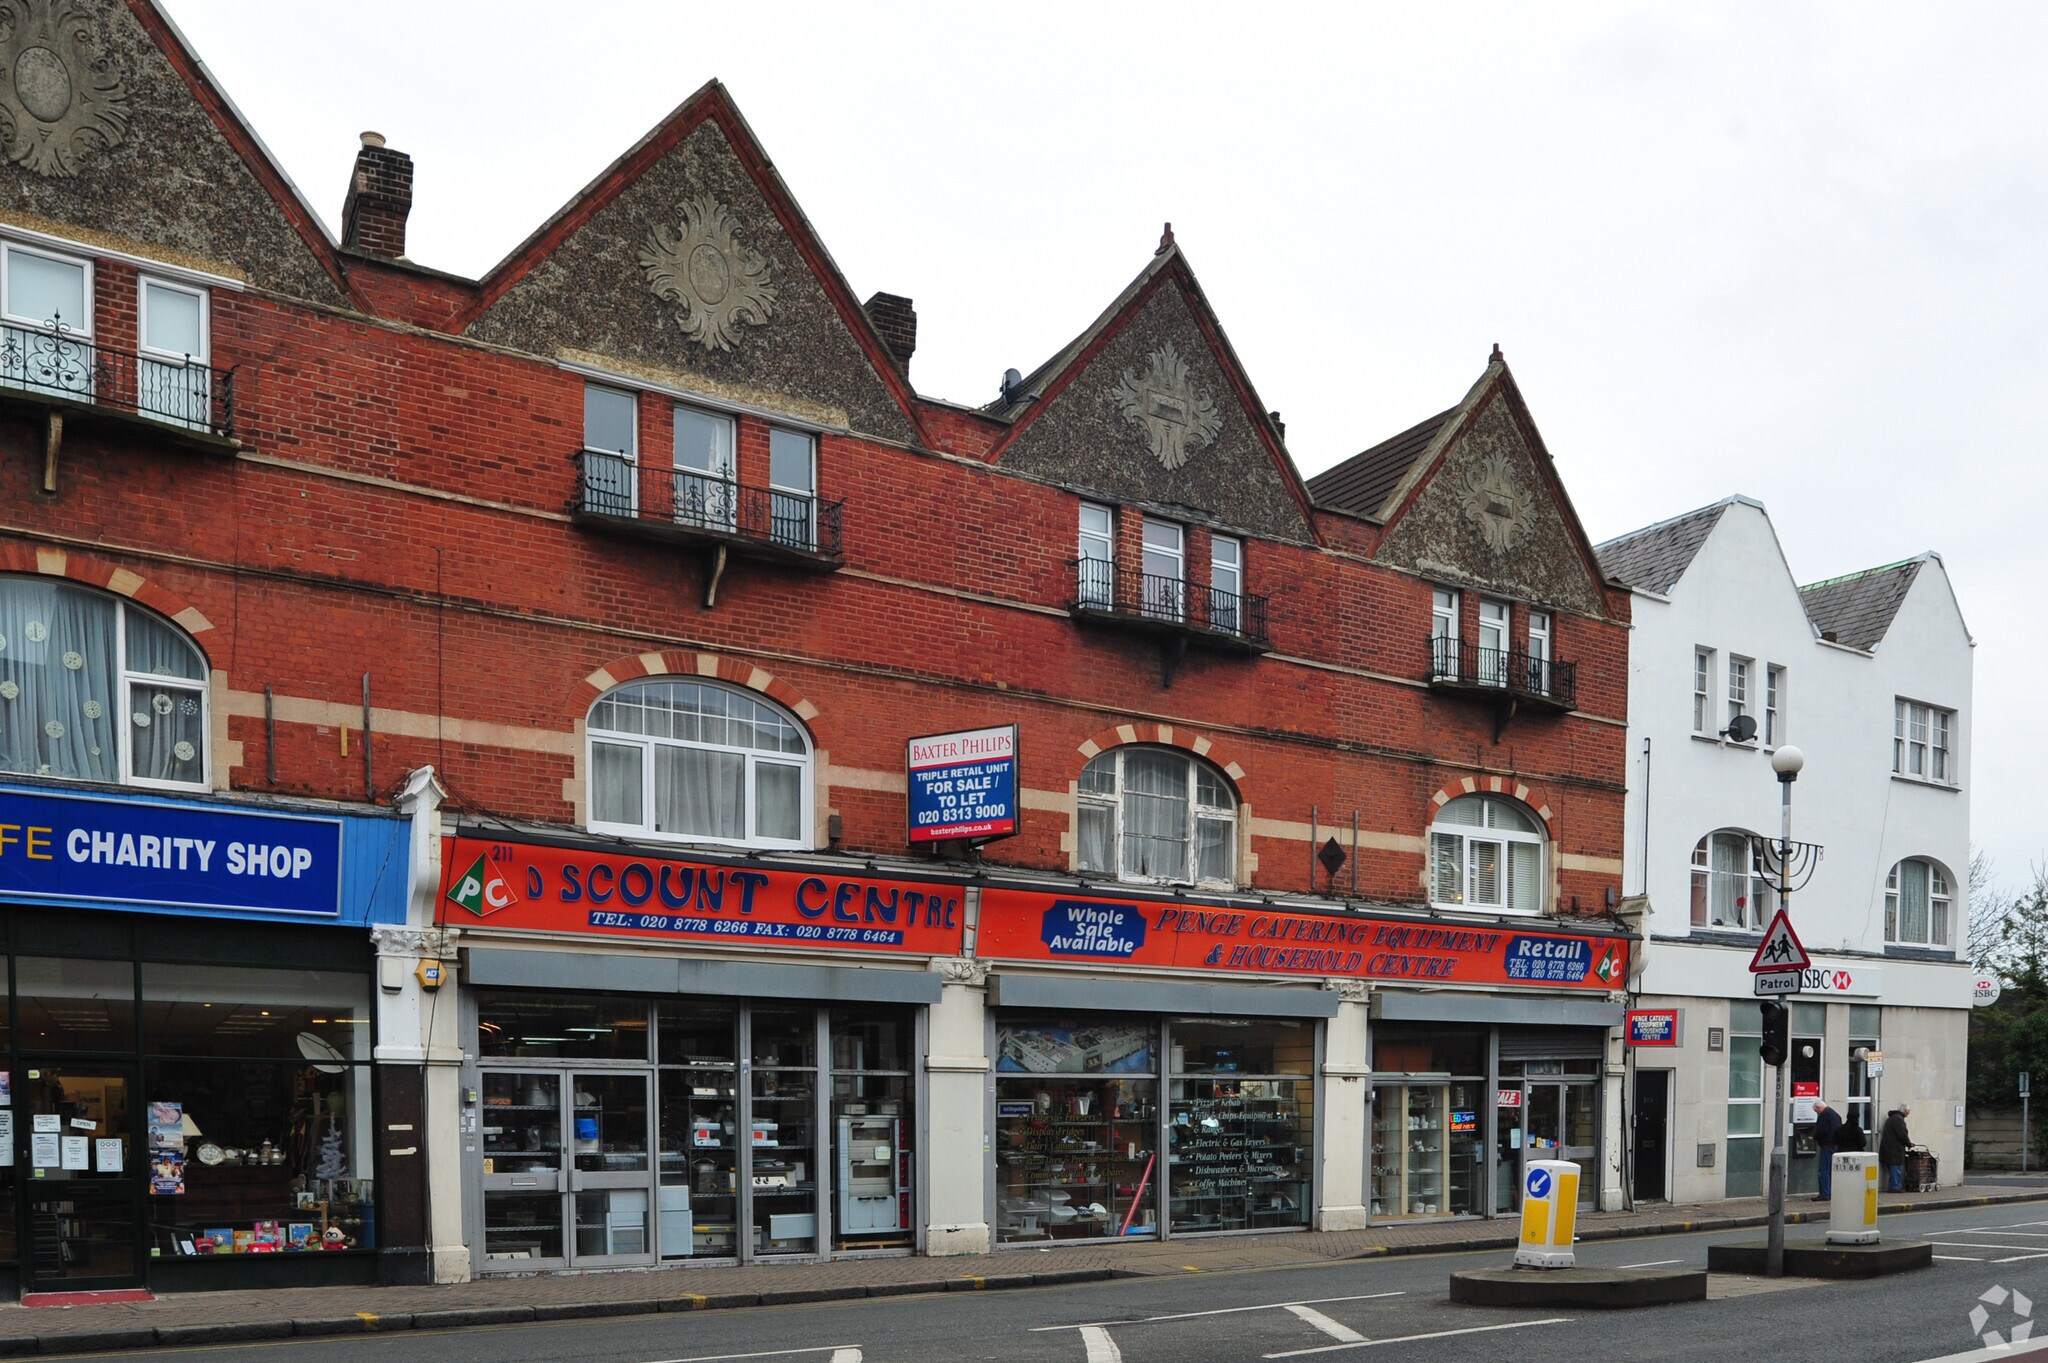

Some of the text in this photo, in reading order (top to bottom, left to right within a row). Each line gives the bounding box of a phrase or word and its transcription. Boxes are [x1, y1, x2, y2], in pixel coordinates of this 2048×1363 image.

[913, 735, 1011, 761] BAXTER PHILIPS
[916, 762, 1010, 782] TRIPLE RETAIL UNIT
[926, 775, 999, 795] FOR SALE /
[938, 792, 986, 808] TO LET
[918, 803, 1006, 824] 020 8313 9000
[66, 828, 217, 872] CHARITY
[226, 841, 313, 878] SHOP
[492, 845, 513, 862] 211
[456, 875, 509, 908] PC
[795, 877, 960, 929] CENTRE
[1067, 907, 1124, 925] Whole
[592, 911, 896, 943] TEL: 020 8778 6266 FAX: 020 8778 6464
[1075, 922, 1113, 938] Sale
[1153, 908, 1502, 954] PENGE CATERING EQUIPMENT
[1050, 935, 1134, 953] Available
[1518, 939, 1582, 959] Retail
[1205, 943, 1458, 978] & HOUSEHOLD CENTRE
[1509, 958, 1585, 971] TEL: 020 8778 6266
[1599, 956, 1620, 977] PC
[1509, 967, 1585, 980] FAX: 020 8778 6464
[1760, 979, 1794, 989] Patrol
[1195, 1098, 1241, 1107] Pizza Kebab
[1195, 1111, 1211, 1120] Fish
[1055, 1126, 1085, 1137] Fridges
[1193, 1125, 1225, 1135] & Ranges
[1195, 1138, 1266, 1148] Electric & Gas Fryers
[1195, 1152, 1217, 1161] Potato
[1220, 1152, 1242, 1161] Peelers
[1251, 1151, 1273, 1160] Mixers
[1195, 1164, 1283, 1175] Dishwashers & Microwaves
[1195, 1178, 1248, 1190] Coffee Machines
